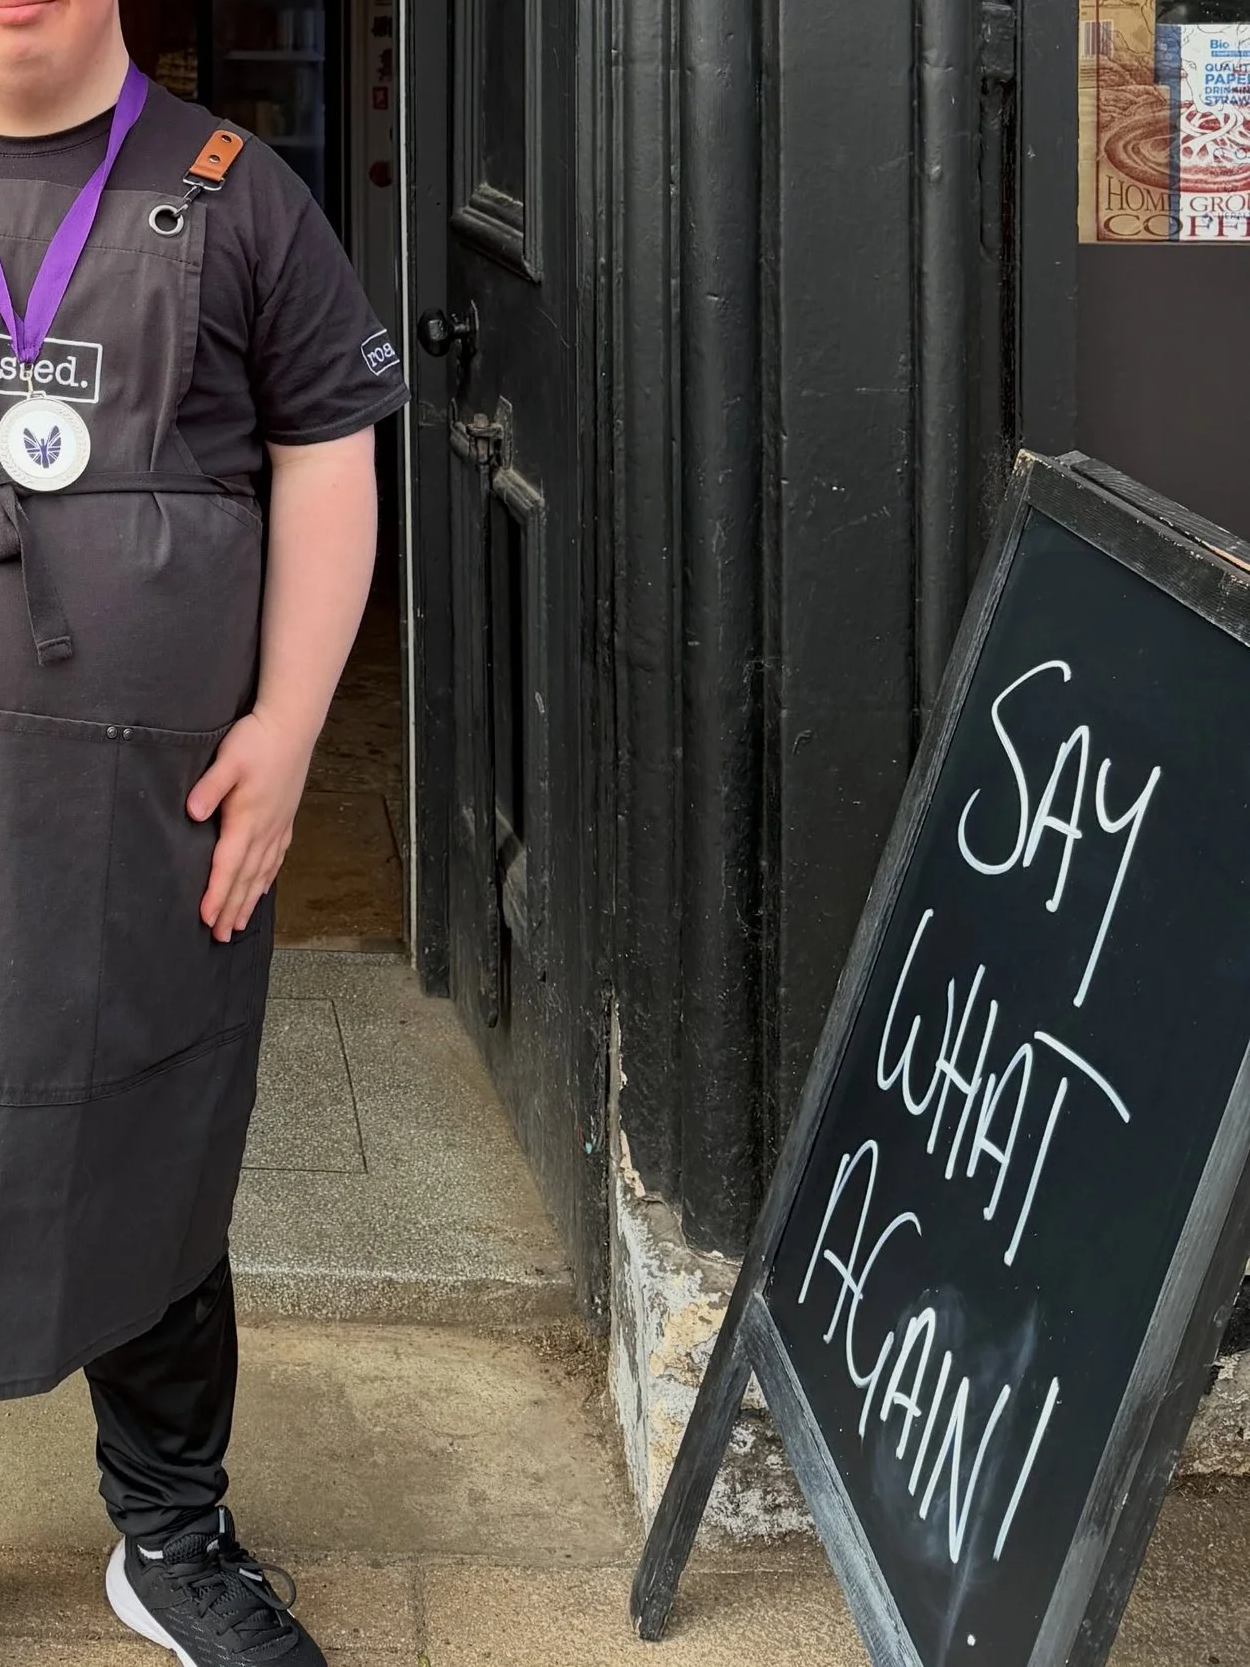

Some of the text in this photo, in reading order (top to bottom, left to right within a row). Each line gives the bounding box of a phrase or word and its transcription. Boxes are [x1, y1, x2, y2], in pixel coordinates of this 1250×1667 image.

[1210, 39, 1230, 49] Bio
[1104, 214, 1250, 237] COFF
[1190, 193, 1250, 213] GRO
[958, 660, 1161, 1007] SAY
[877, 908, 1131, 1266] WHAT
[798, 1138, 1060, 1646] AGAIN!
